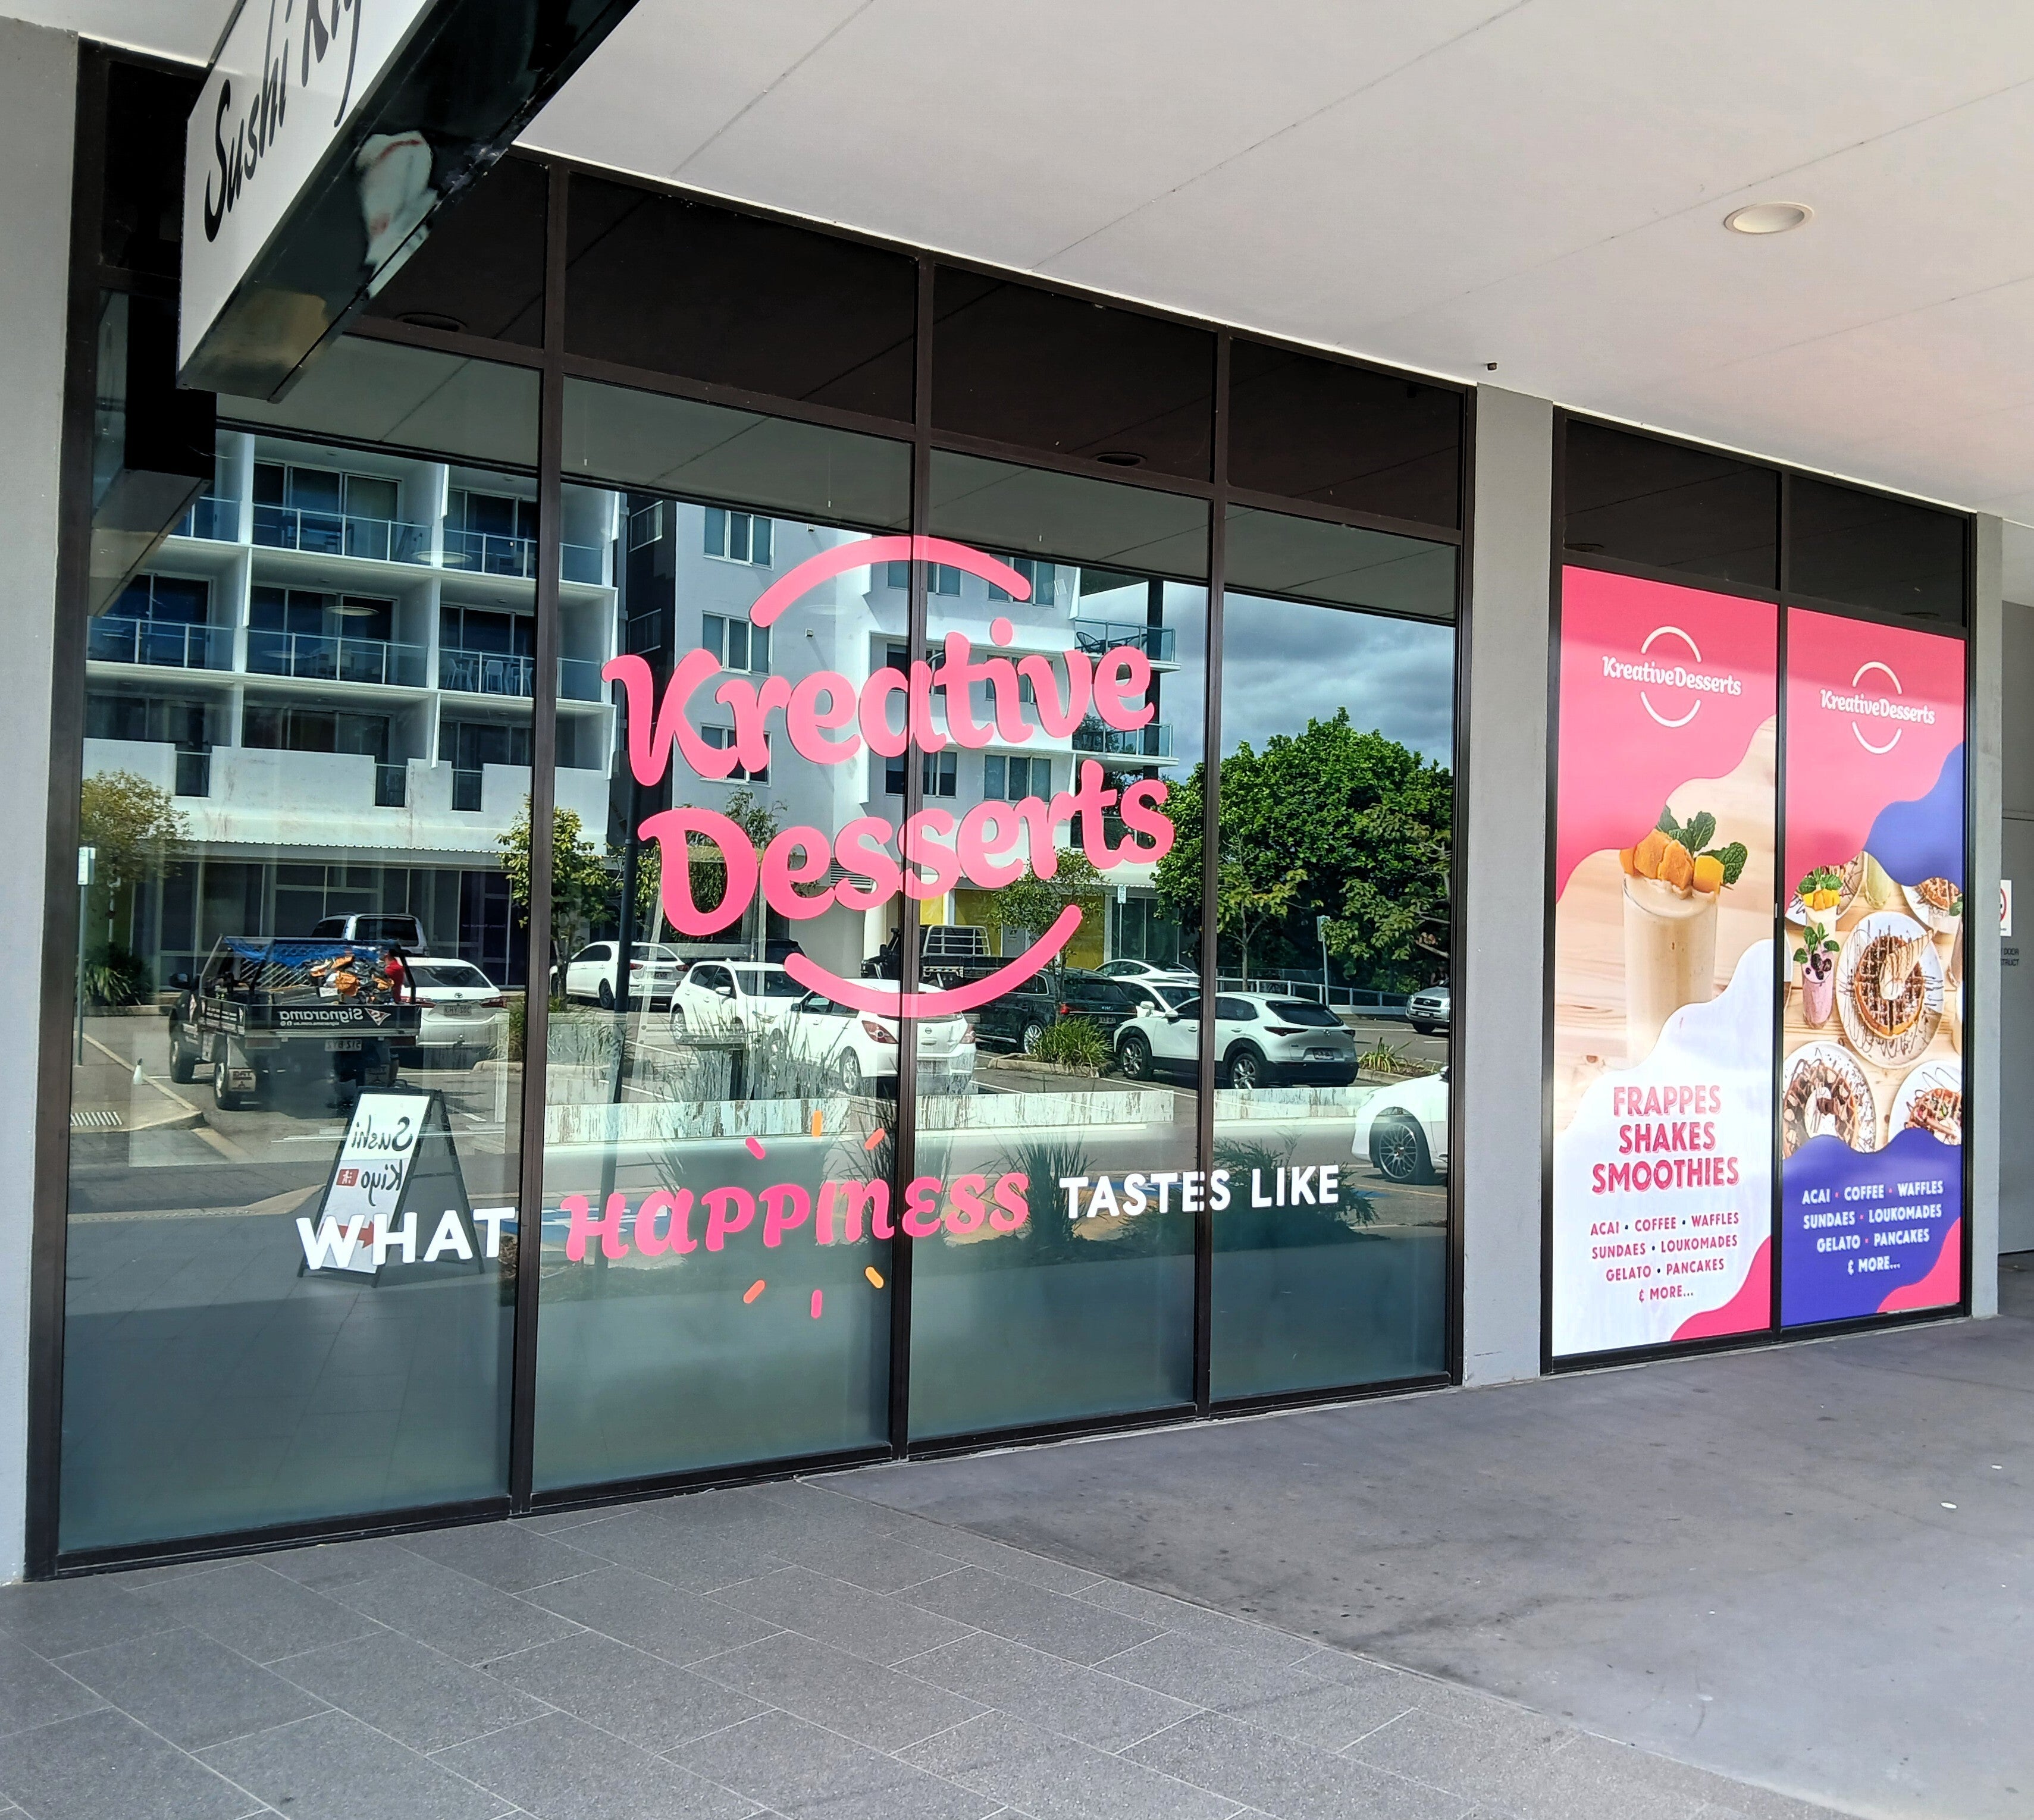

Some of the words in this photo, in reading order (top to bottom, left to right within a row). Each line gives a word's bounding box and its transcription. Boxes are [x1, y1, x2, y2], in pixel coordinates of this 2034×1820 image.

[204, 0, 293, 243] Sushi
[601, 617, 1155, 786] Kreative
[637, 759, 1176, 936] Desserts
[1613, 1085, 1722, 1116] FRAPPES
[1618, 1121, 1716, 1154] SHAKES
[1591, 1156, 1740, 1195] SMOOTHIES
[1802, 1188, 1831, 1205] ACAI
[1844, 1184, 1885, 1201] COFFEE
[1897, 1181, 1944, 1197] WAFFLES
[296, 1207, 516, 1270] WHAT
[1059, 1169, 1231, 1219] TASTES
[1251, 1165, 1340, 1208] LIKE
[1590, 1221, 1620, 1236] ACAI
[1634, 1217, 1677, 1233] COFFEE
[1691, 1212, 1740, 1228] WAFFLES
[1803, 1210, 1856, 1229] SUNDAES
[1868, 1203, 1942, 1223] LOUKOMADES
[1591, 1242, 1646, 1260] SUNDAES
[1660, 1234, 1738, 1254] LOUKOMADES
[1816, 1234, 1861, 1253] GELATO
[1873, 1228, 1930, 1247] PANCAKES
[1606, 1266, 1651, 1282] GELATO
[1666, 1258, 1725, 1275] PANCAKES
[1858, 1256, 1901, 1273] MORE...
[1649, 1285, 1694, 1301] MORE...
